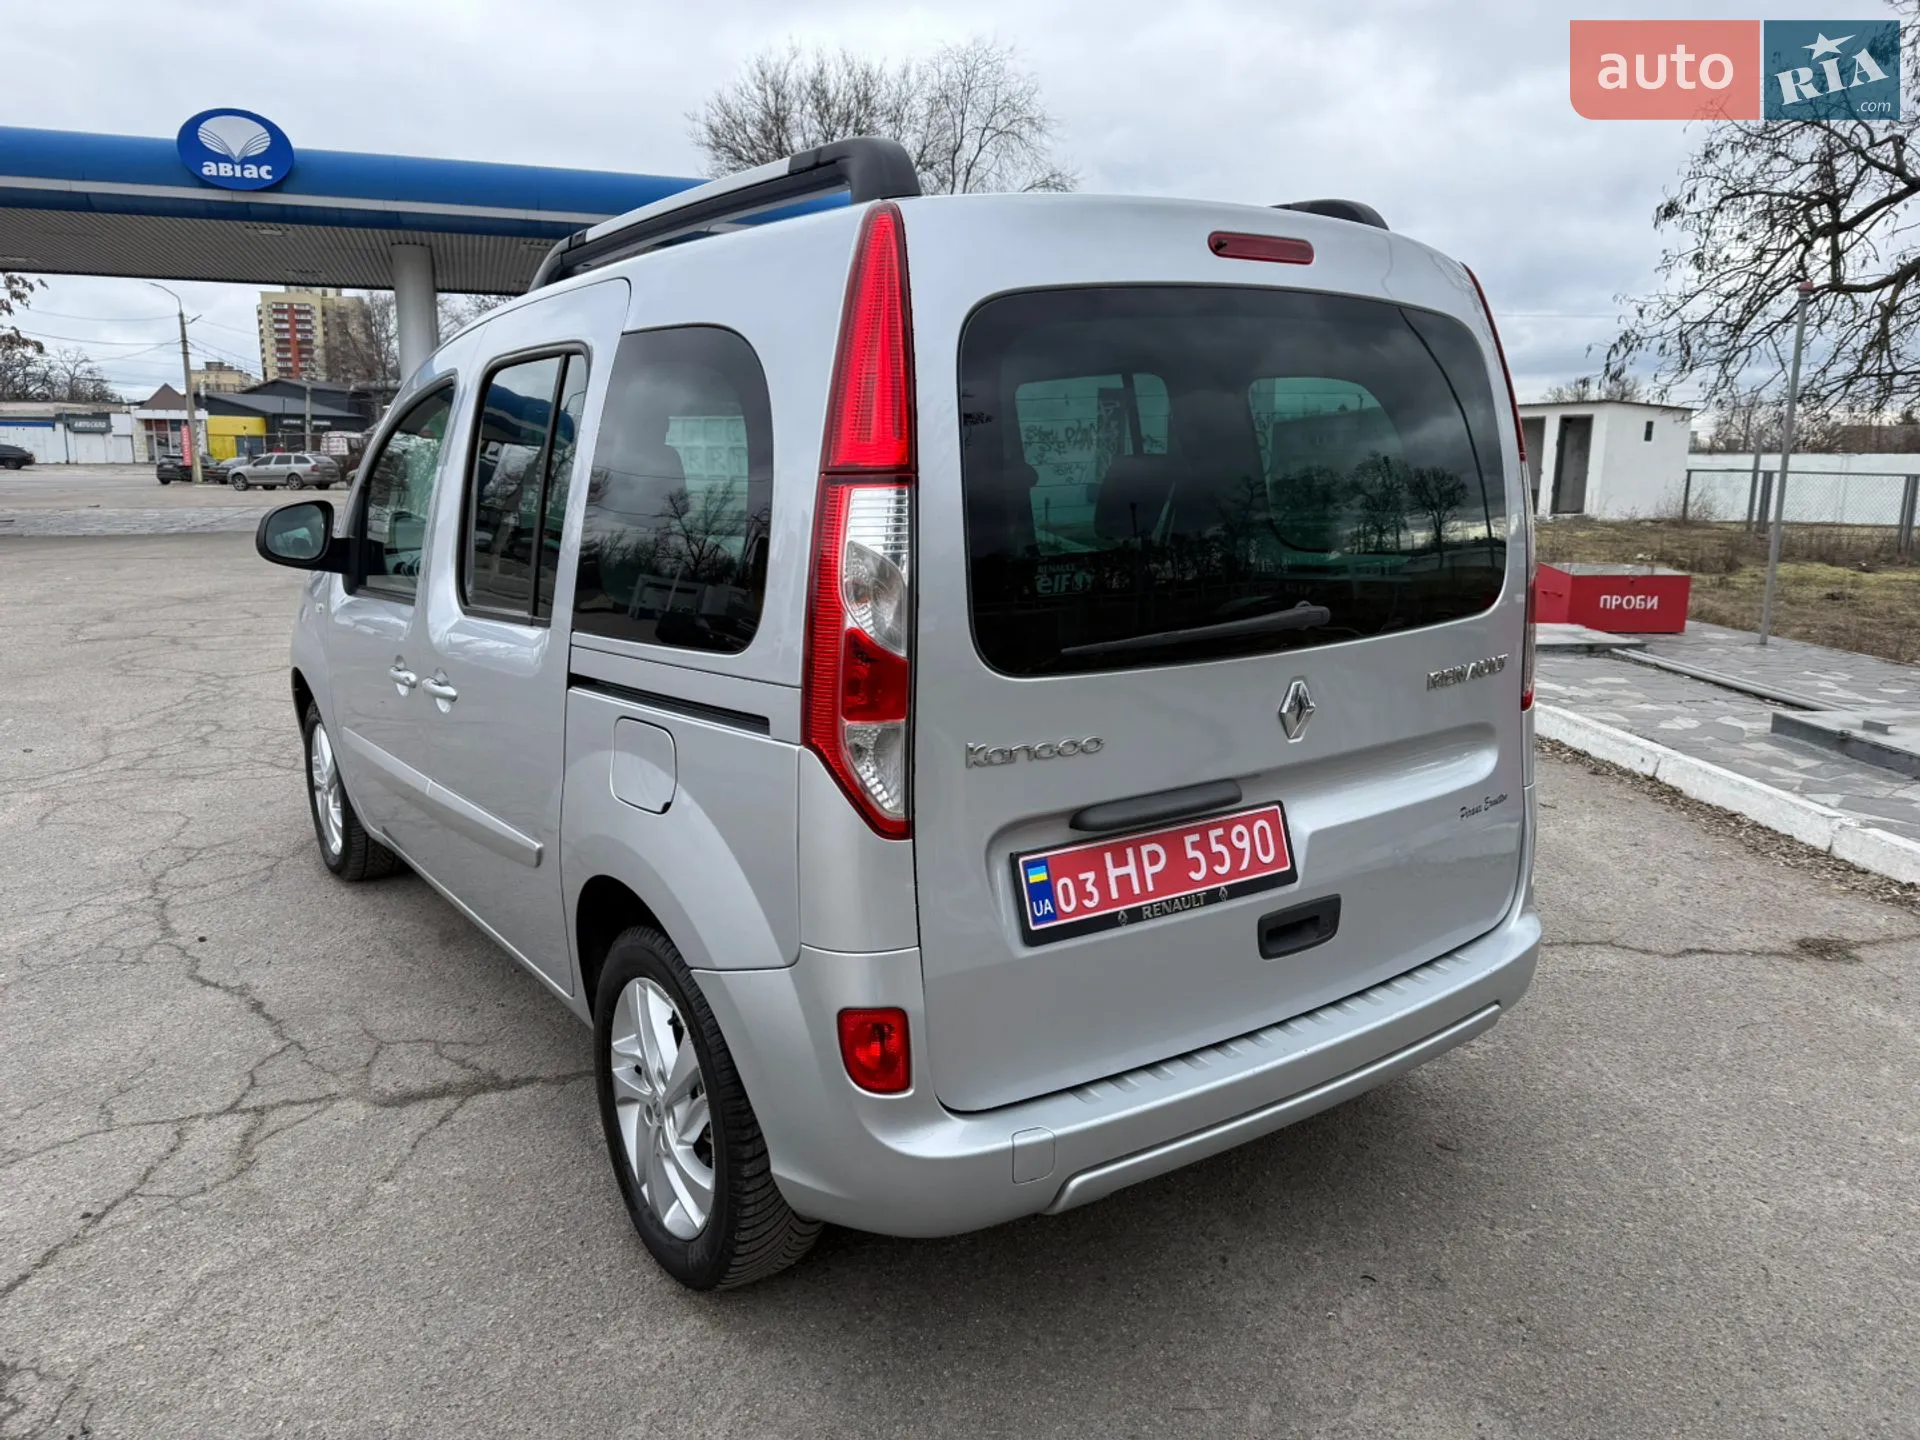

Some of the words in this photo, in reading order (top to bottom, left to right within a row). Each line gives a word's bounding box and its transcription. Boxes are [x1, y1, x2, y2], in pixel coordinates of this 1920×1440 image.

[1599, 594, 1660, 611] ПРОБИ
[1056, 871, 1100, 914] 03
[1104, 843, 1167, 900] HP
[1184, 819, 1276, 881] 5590
[1032, 898, 1054, 917] UA
[1142, 892, 1208, 920] RENAULT
